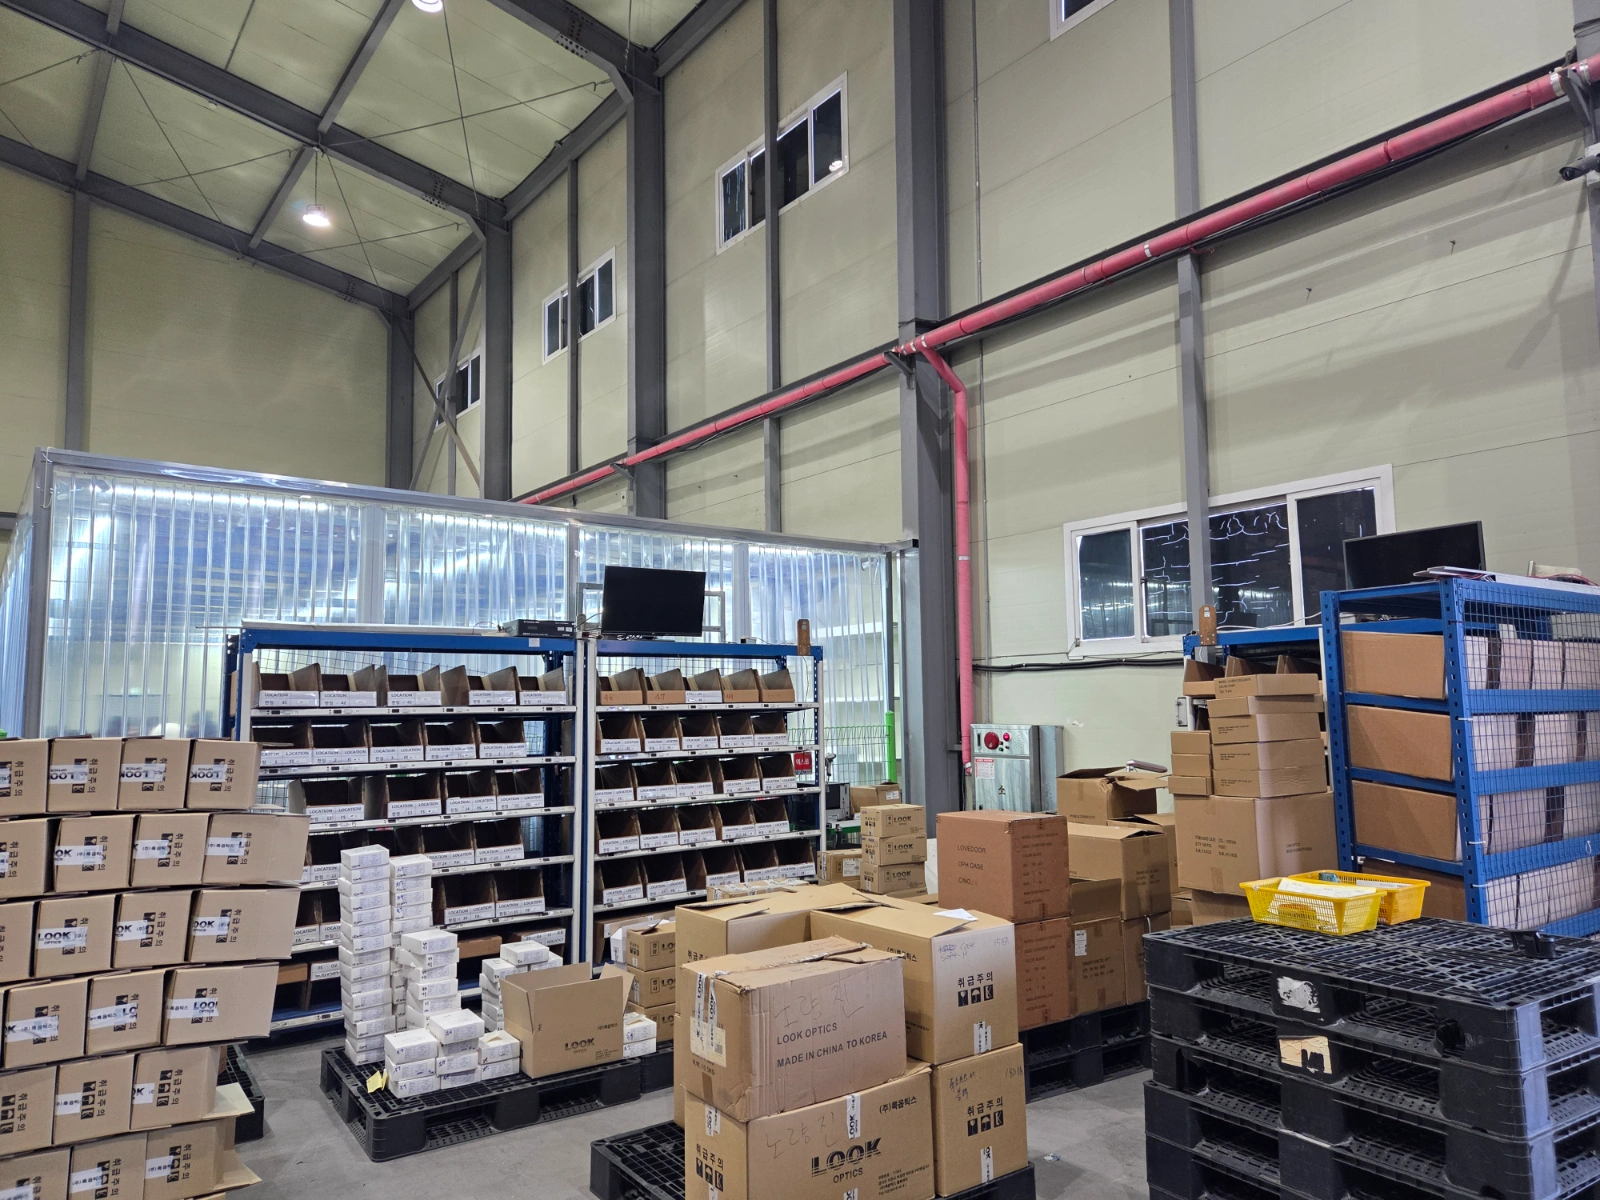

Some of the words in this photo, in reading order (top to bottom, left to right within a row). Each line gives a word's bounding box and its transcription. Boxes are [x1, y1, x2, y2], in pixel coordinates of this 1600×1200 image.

[190, 770, 220, 779] LOOK
[957, 844, 986, 854] LOVEDOOR
[38, 932, 70, 941] LOOK
[958, 971, 993, 988] 취급주의
[564, 1038, 594, 1052] LOOK
[776, 1030, 802, 1045] LOOK
[805, 1022, 838, 1038] OPTICS
[776, 1054, 804, 1068] MADE
[805, 1050, 814, 1060] IN
[816, 1043, 844, 1058] CHINA
[846, 1038, 858, 1050] TO
[859, 1031, 888, 1046] KOREA
[96, 1079, 108, 1117] 취급주의
[170, 1069, 183, 1106] 취급주의
[16, 1093, 28, 1132] 취급주의
[879, 1096, 917, 1114] (주)룩옵틱스
[967, 1096, 1003, 1116] 취급주의
[182, 1144, 192, 1180] 취급주의
[696, 1143, 724, 1171] 취급주의
[811, 1137, 882, 1178] LOOK
[110, 1158, 122, 1196] 취급주의
[832, 1168, 864, 1184] OPTICS
